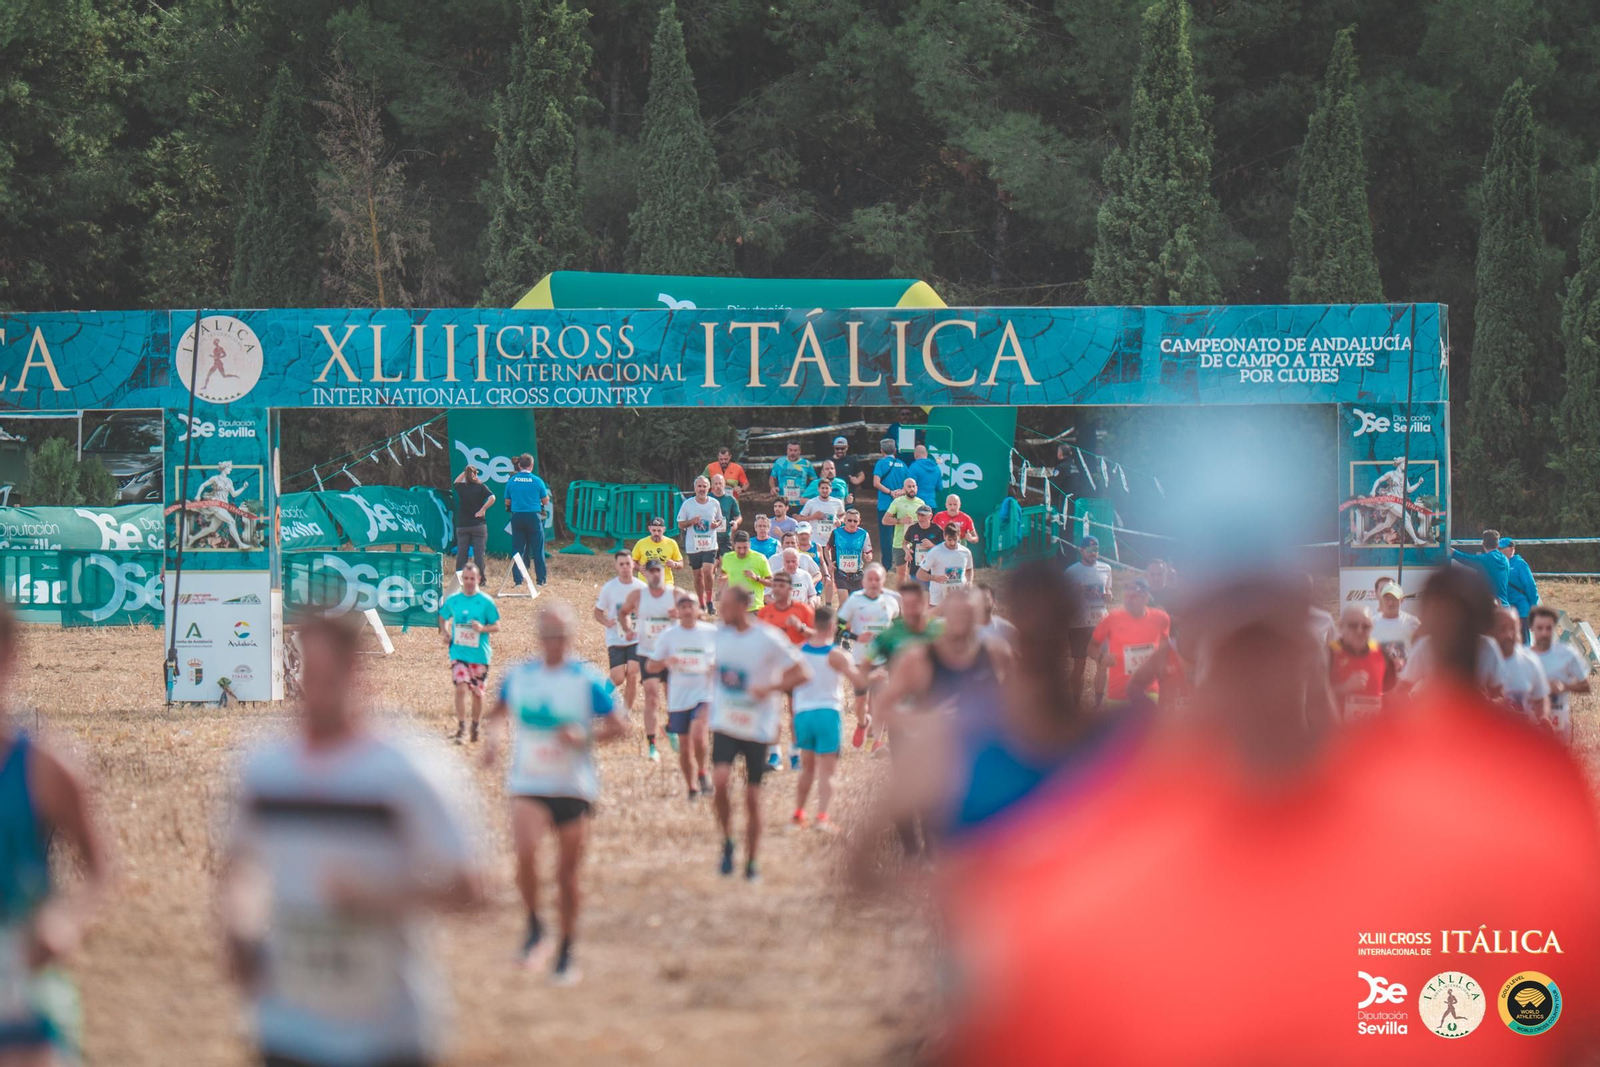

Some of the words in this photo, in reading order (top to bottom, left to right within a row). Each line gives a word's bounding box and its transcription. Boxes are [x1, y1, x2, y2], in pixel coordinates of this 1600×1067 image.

[496, 324, 635, 360] CROSS
[700, 308, 1041, 388] ITÁLICA
[1160, 337, 1281, 353] CAMPEONATO
[1284, 337, 1306, 352] DE
[1309, 333, 1412, 351] ANDALUCÍA
[312, 323, 492, 383] XLIII
[1200, 355, 1223, 368] DE
[1225, 353, 1289, 368] CAMPO
[1293, 354, 1306, 367] A
[1309, 349, 1375, 367] TRAVÉS
[496, 363, 687, 383] INTERNACIONAL
[1239, 369, 1274, 383] POR
[1277, 368, 1340, 383] CLUBES
[312, 387, 482, 406] INTERNATIONAL
[486, 387, 550, 406] CROSS
[554, 386, 653, 405] COUNTRY
[218, 419, 255, 428] Diputación
[1393, 414, 1430, 423] Dipuación
[218, 426, 255, 438] Sevilla
